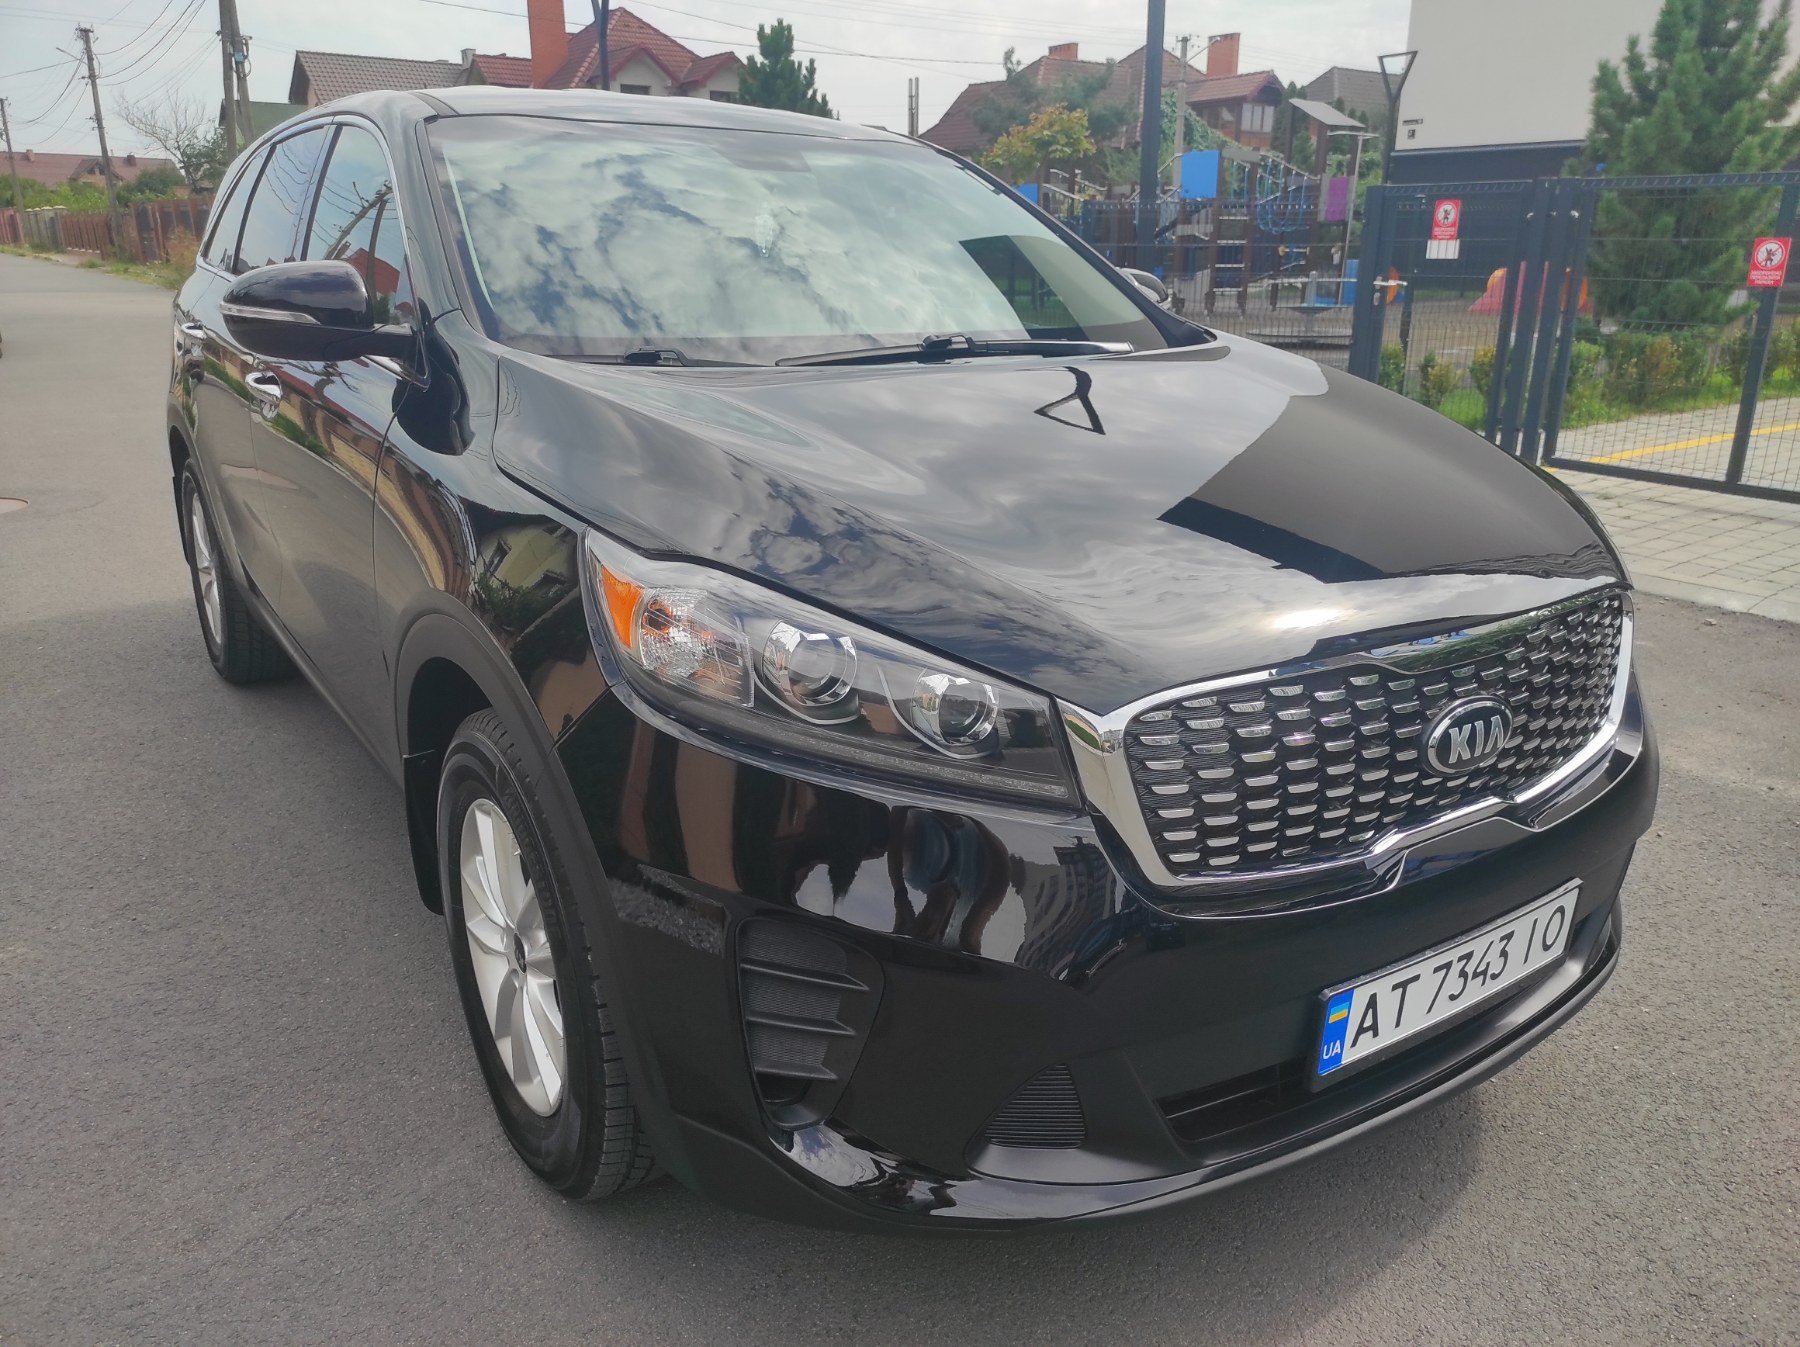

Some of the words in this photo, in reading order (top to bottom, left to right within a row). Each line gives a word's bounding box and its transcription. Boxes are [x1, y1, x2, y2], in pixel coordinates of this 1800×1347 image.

[1448, 714, 1504, 764] KIA
[1350, 973, 1421, 1049] AT
[1425, 929, 1515, 1015] 7343
[1522, 904, 1567, 965] IO
[1322, 1039, 1341, 1060] UA
